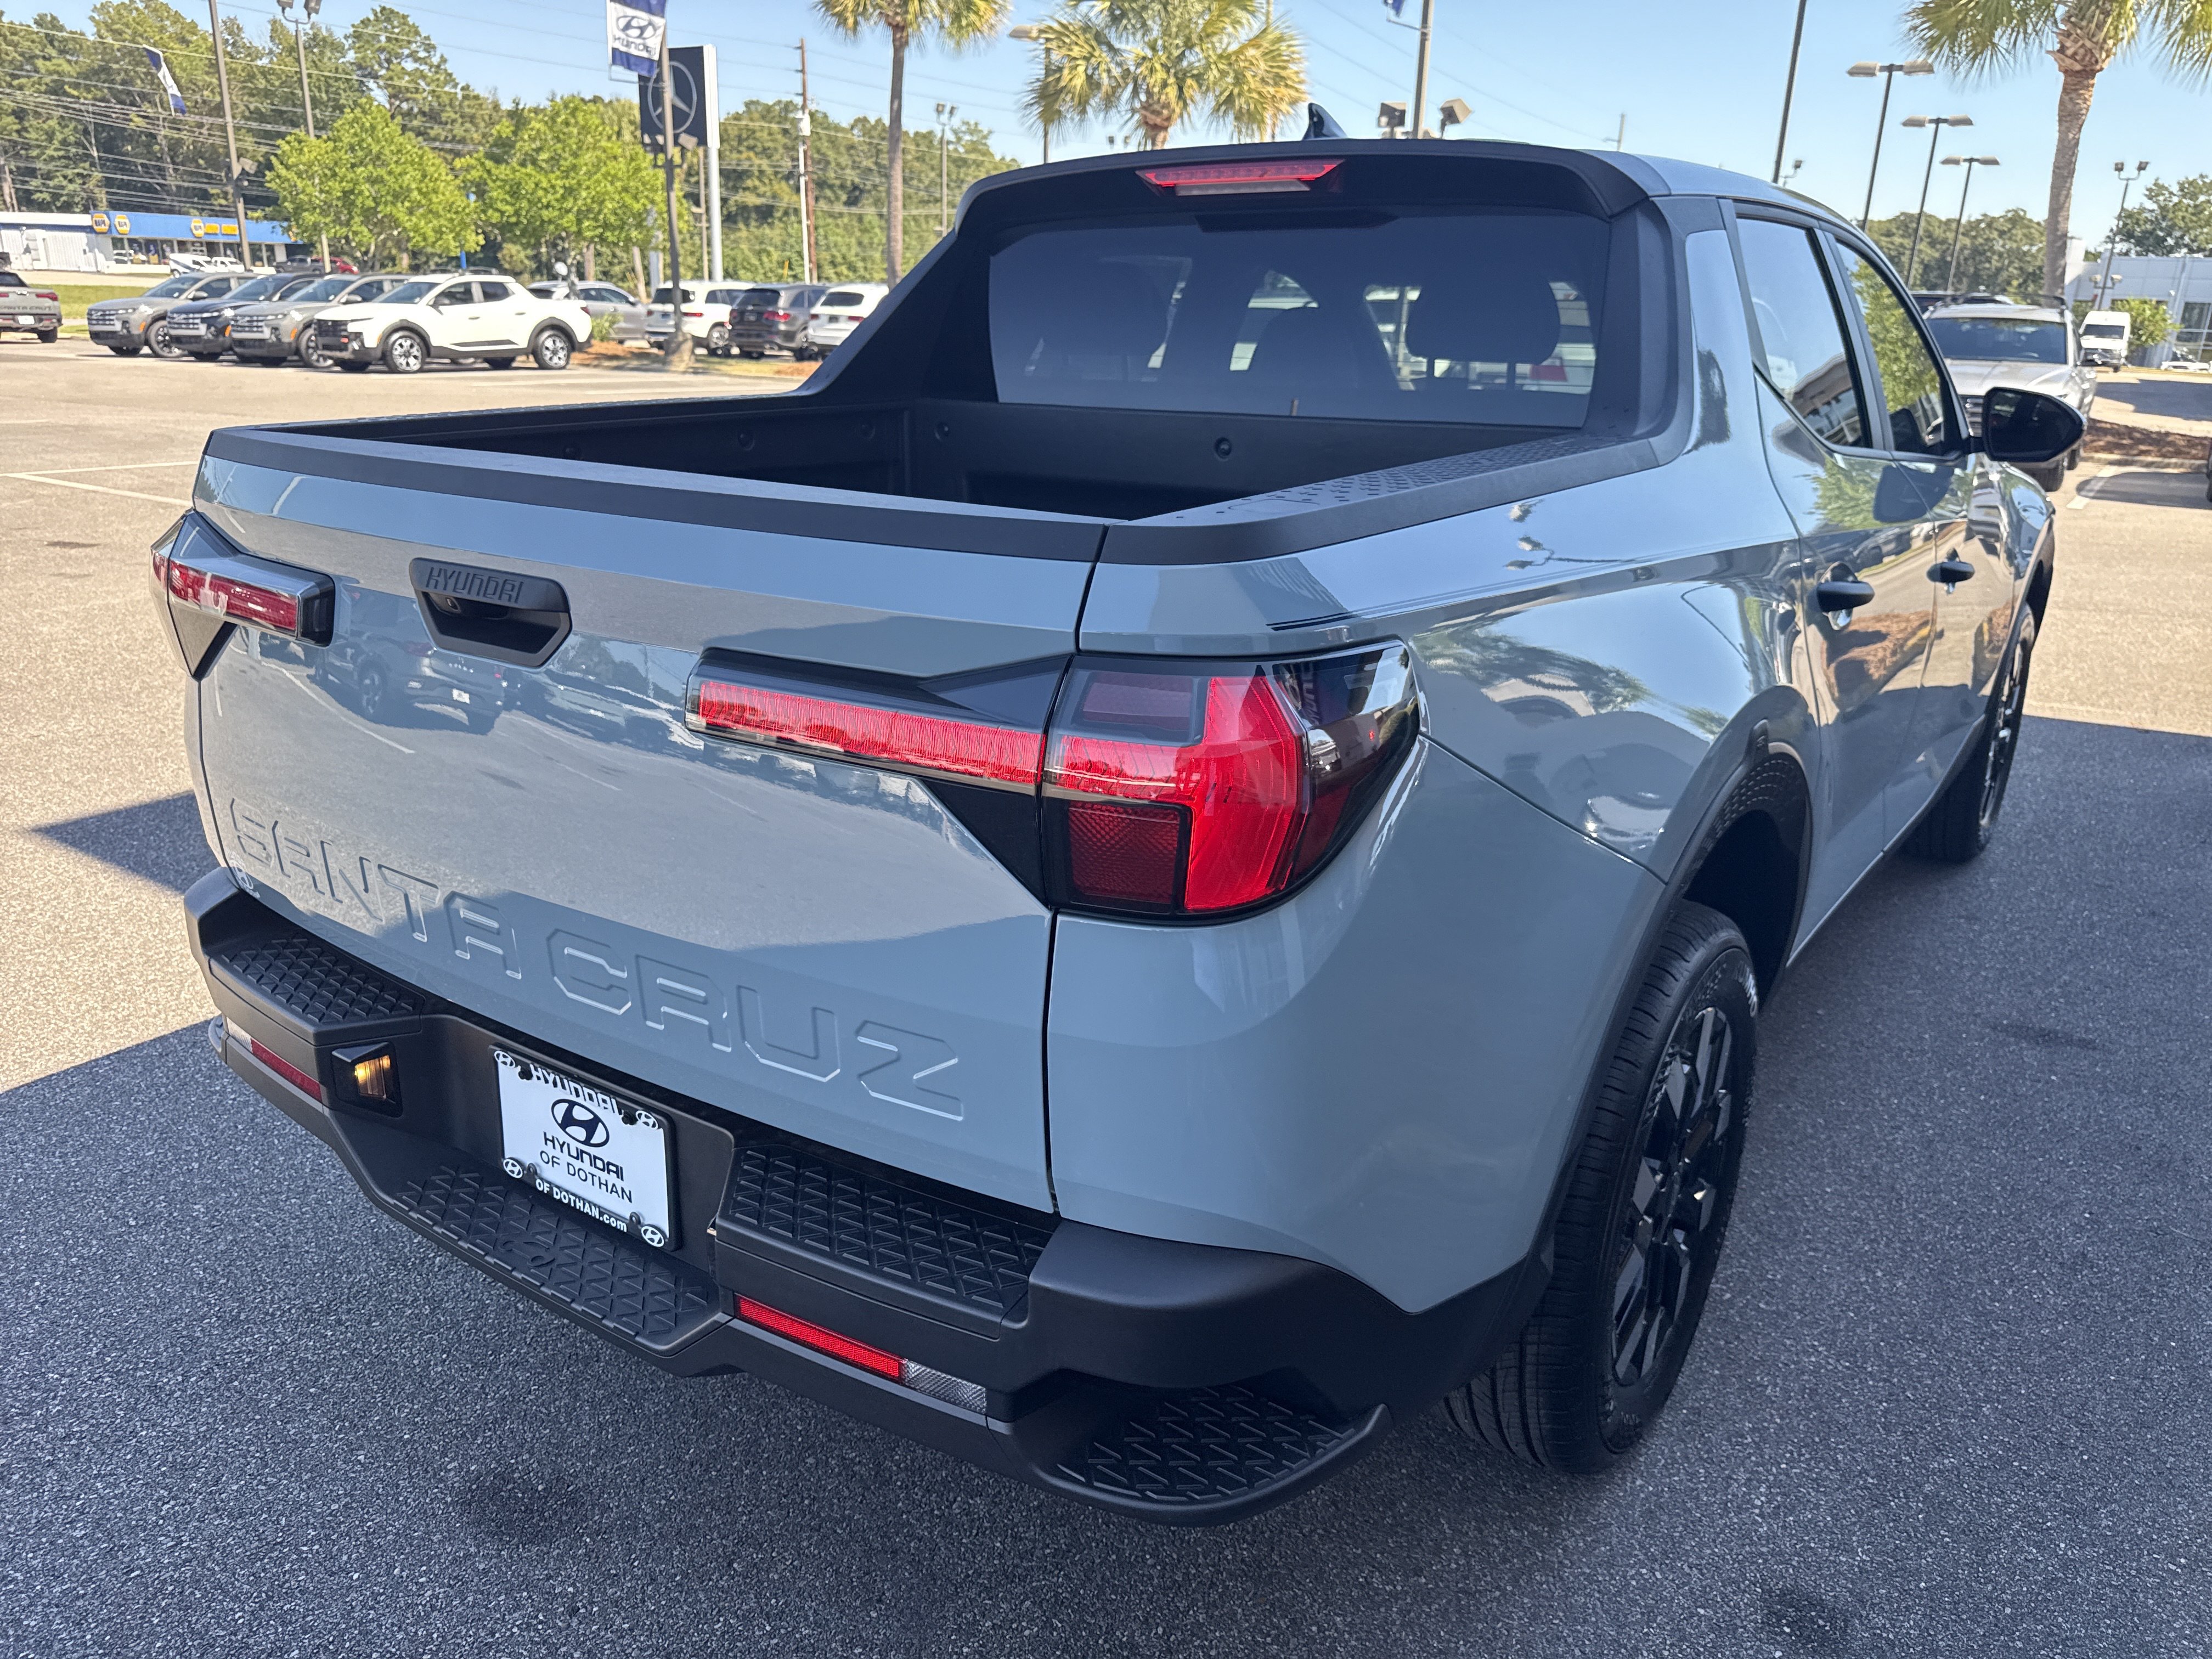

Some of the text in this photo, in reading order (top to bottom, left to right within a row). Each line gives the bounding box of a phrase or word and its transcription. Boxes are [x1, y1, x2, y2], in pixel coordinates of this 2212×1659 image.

[425, 566, 524, 604] HYUNDAI
[229, 797, 965, 1122] SANTA CRUZ
[529, 1063, 620, 1115] HYUNDAI
[540, 1150, 633, 1204] OF DOTHAN
[543, 1131, 624, 1182] HYUNDAI
[535, 1178, 627, 1233] OF DOTHAN.com
